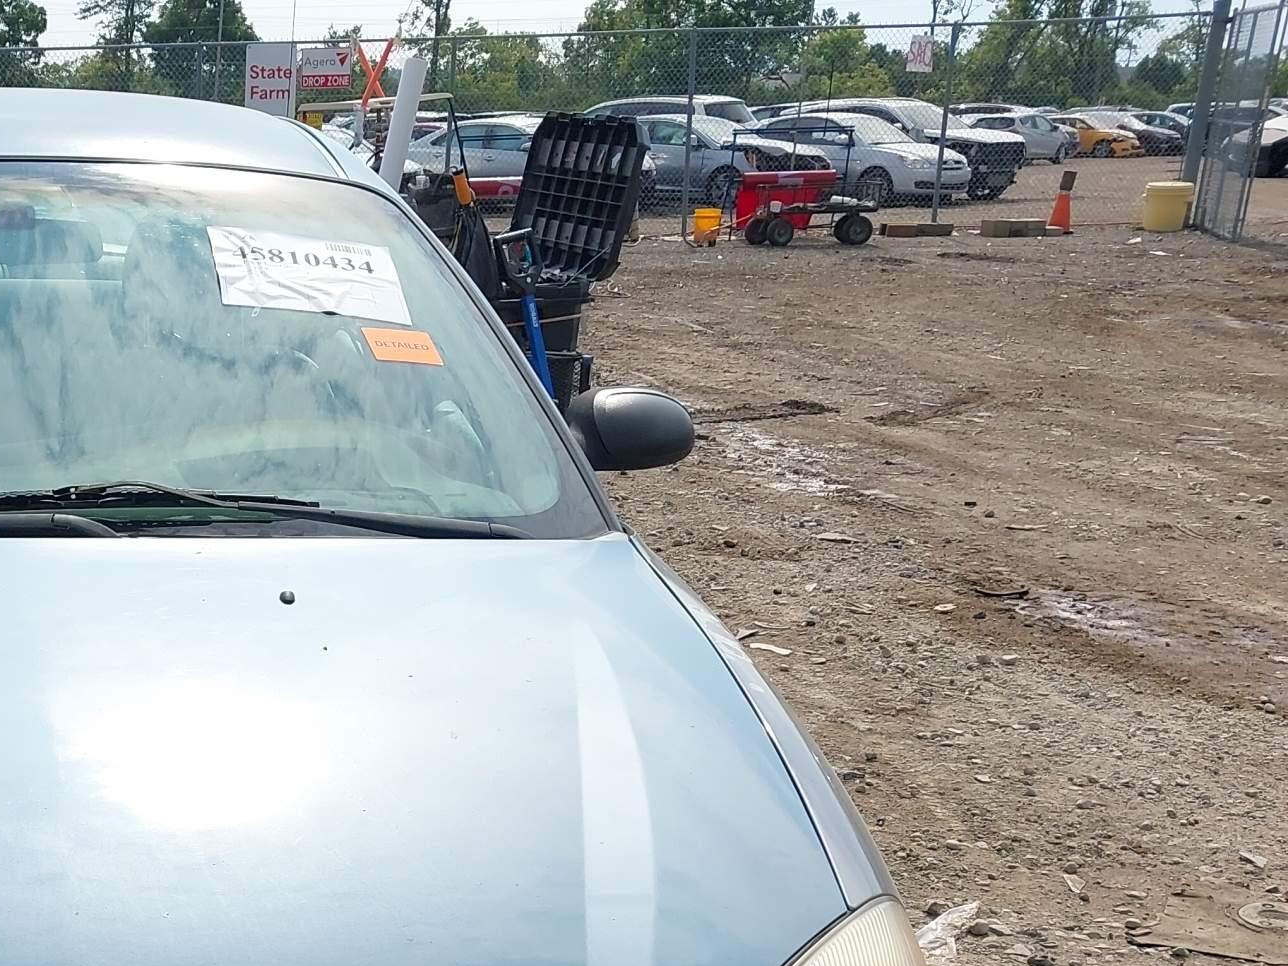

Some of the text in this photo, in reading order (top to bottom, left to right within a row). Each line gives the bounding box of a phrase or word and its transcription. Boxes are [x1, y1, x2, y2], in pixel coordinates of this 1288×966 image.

[304, 57, 336, 68] Agero
[250, 65, 292, 79] State
[303, 76, 350, 87] DROP ZONE
[250, 86, 290, 100] Farm
[232, 246, 375, 274] 45810434
[374, 340, 430, 351] DETAILED
